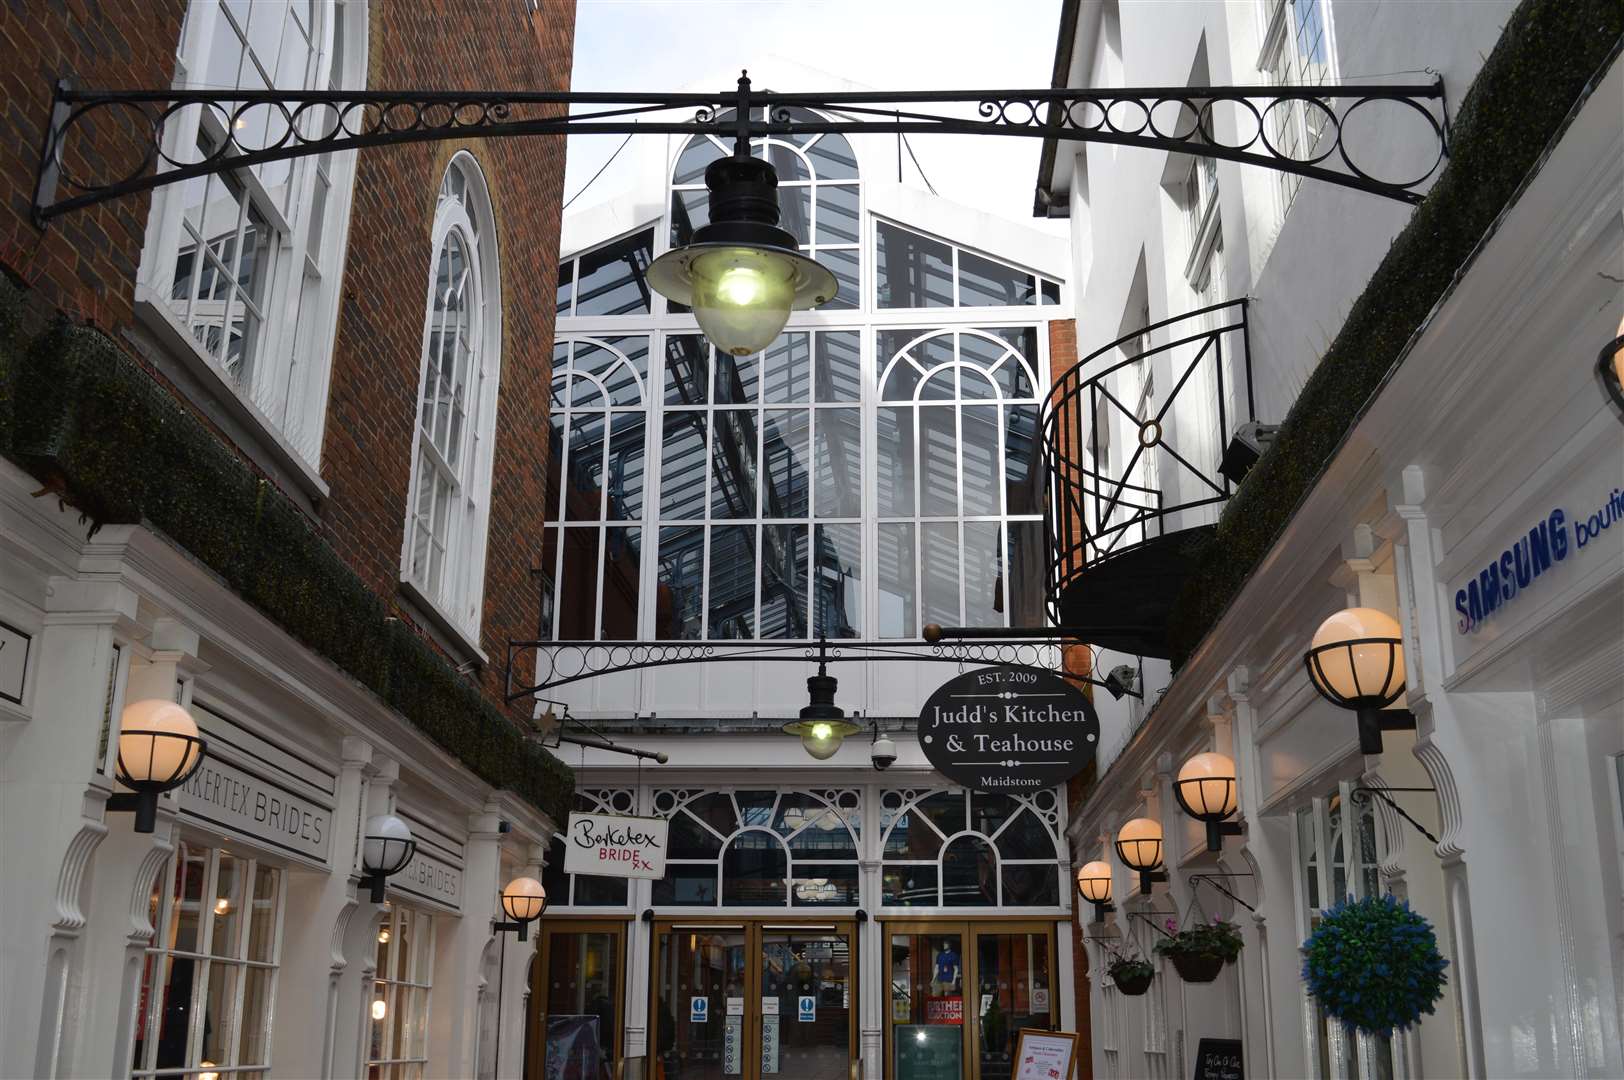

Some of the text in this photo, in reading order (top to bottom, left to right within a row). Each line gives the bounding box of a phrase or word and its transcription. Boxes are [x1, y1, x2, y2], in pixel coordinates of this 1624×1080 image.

[1455, 508, 1568, 634] SAMSUNG
[978, 672, 1038, 686] EST. 2009
[932, 704, 1087, 728] Judd's Kitchen
[946, 733, 1074, 753] & Teahouse
[981, 776, 1041, 787] Maidstone
[254, 791, 323, 844] BRIDES
[574, 819, 661, 849] Berketex
[599, 847, 641, 861] BRIDE
[419, 862, 456, 896] BRIDES
